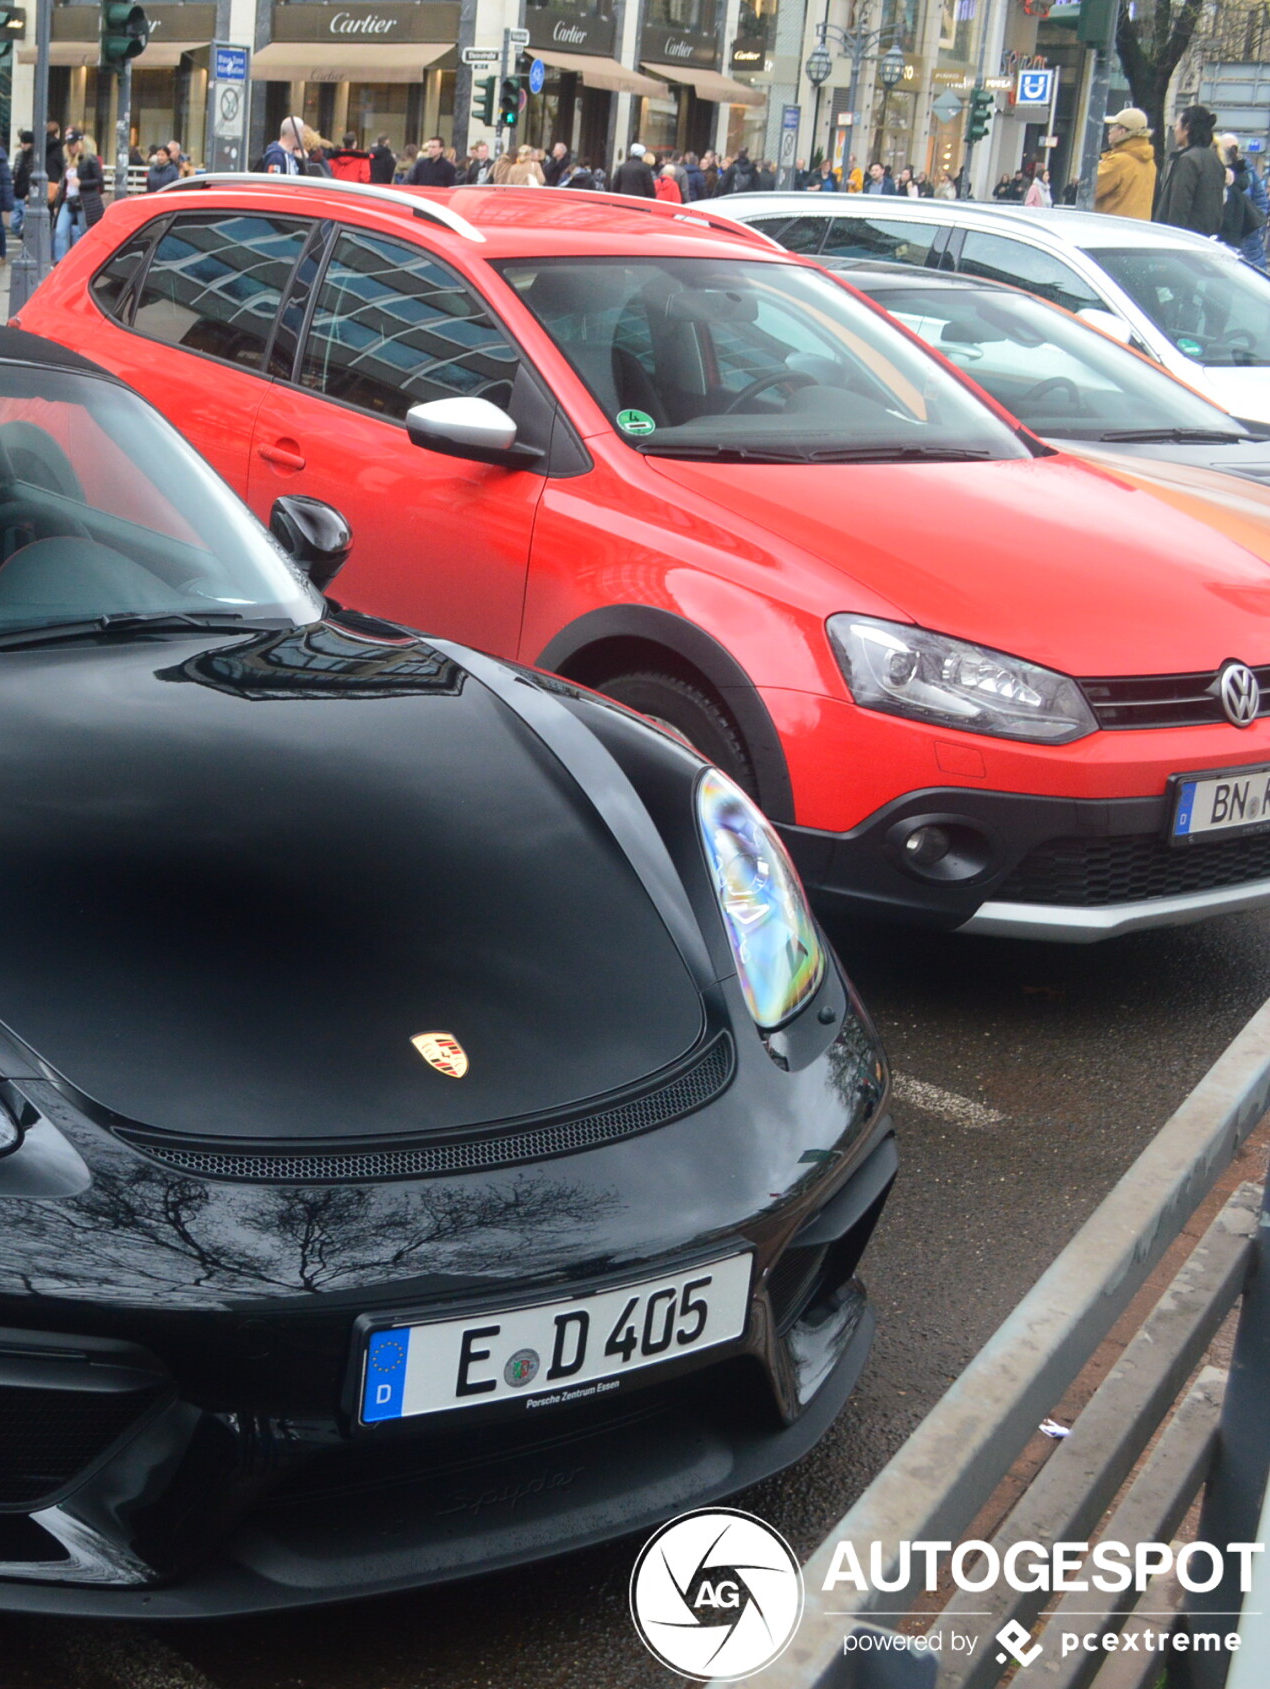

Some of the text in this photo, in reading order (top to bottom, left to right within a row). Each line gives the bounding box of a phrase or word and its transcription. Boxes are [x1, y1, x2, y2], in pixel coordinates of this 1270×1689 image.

[329, 12, 397, 34] Cartier
[553, 19, 588, 44] Cartier
[664, 36, 694, 58] Cartier
[1210, 781, 1250, 824] BN
[456, 1276, 713, 1398] E D 405
[376, 1384, 392, 1405] D
[526, 1380, 620, 1409] Porsche Zentrum Essen
